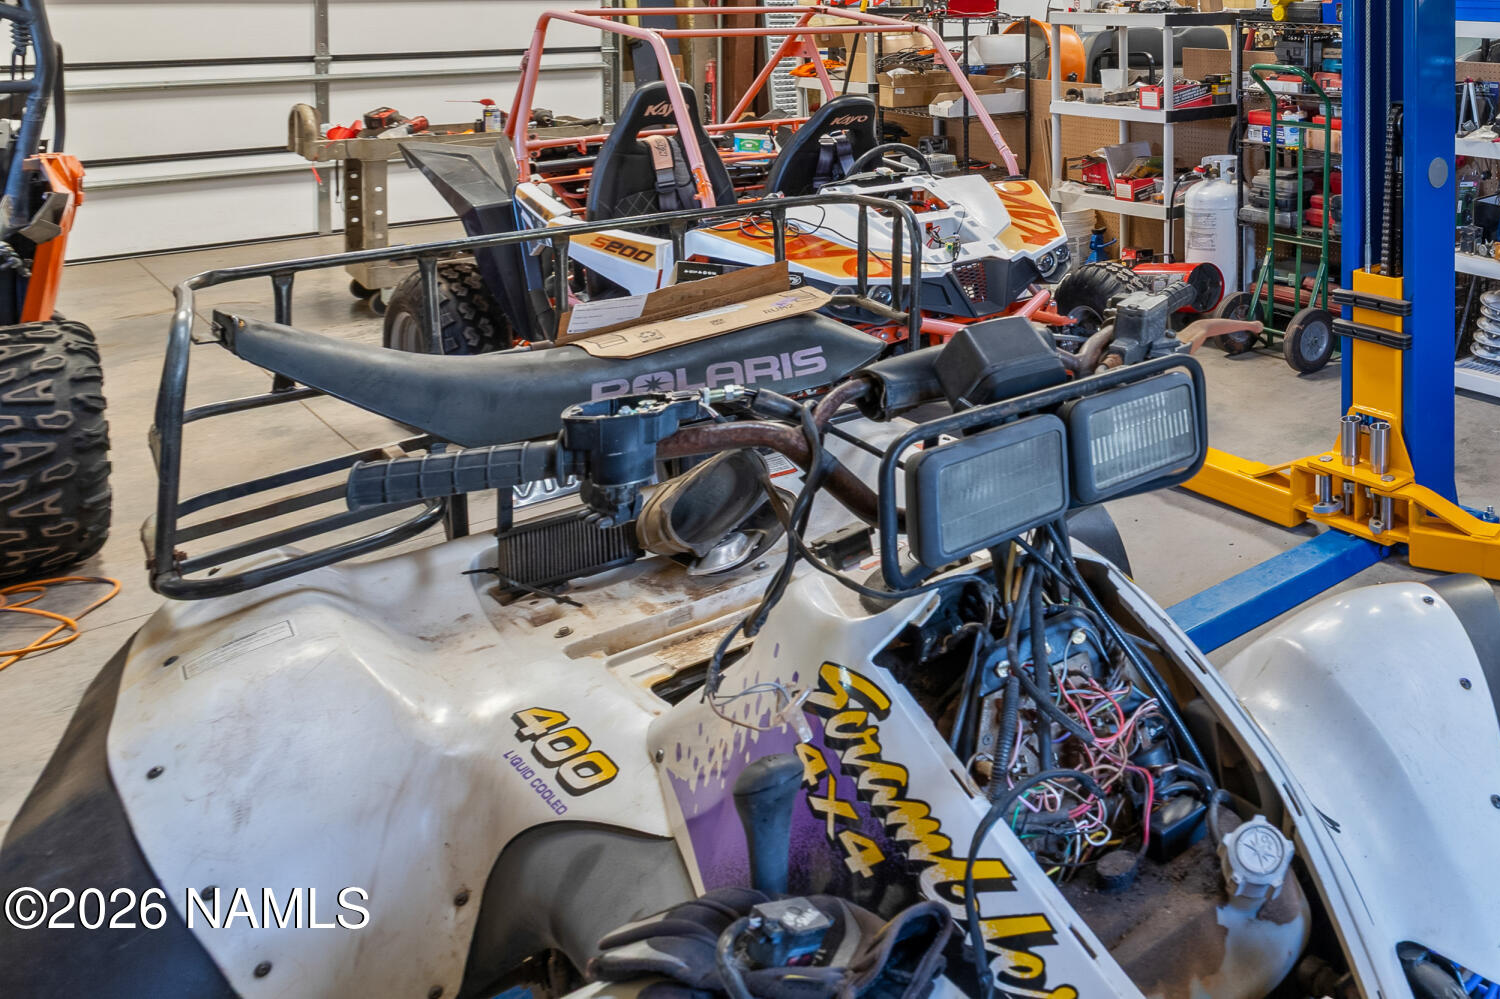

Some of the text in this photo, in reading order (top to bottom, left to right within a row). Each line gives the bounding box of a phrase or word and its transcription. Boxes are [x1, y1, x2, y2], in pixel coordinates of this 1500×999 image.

[644, 100, 690, 117] KAY
[591, 236, 654, 263] S200
[591, 346, 827, 402] POLARIS
[502, 749, 536, 781] LIQUID
[510, 706, 620, 797] 400
[530, 777, 568, 816] COOLED
